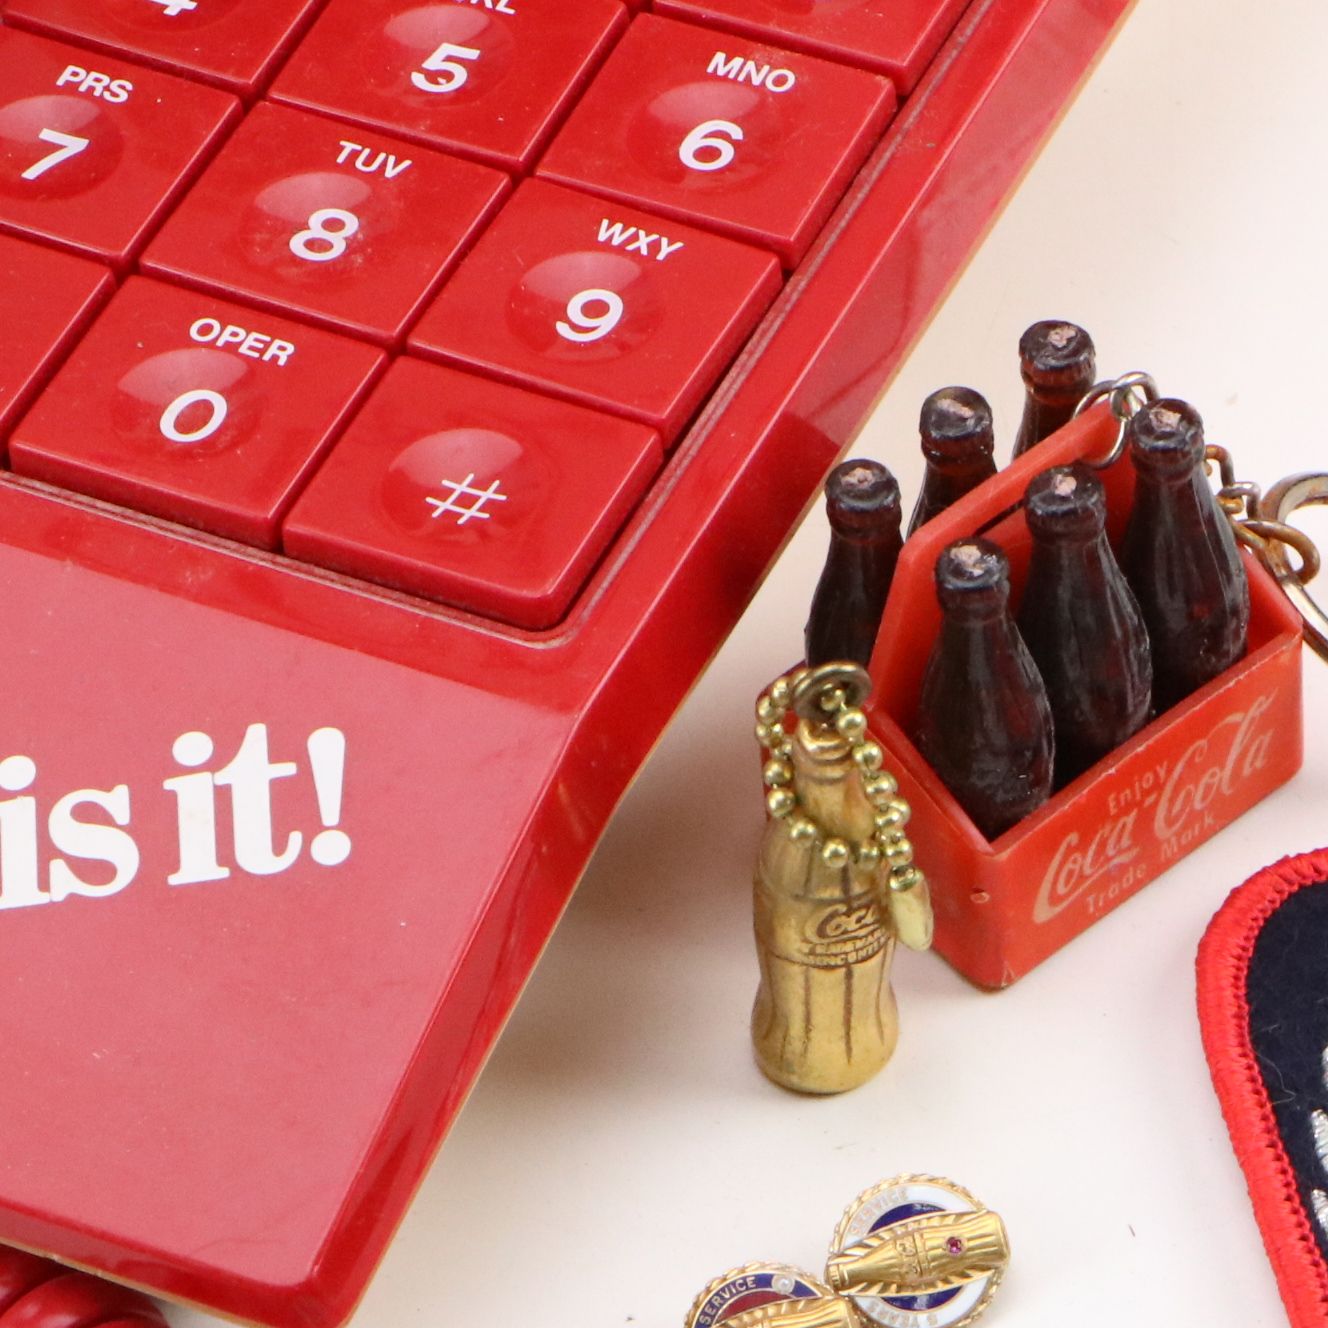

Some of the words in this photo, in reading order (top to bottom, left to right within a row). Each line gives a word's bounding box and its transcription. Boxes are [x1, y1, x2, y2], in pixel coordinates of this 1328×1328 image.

[56, 65, 133, 104] PRS
[410, 42, 481, 93] 5
[706, 51, 797, 93] MNO
[21, 127, 89, 180] 7
[335, 140, 412, 178] TUV
[678, 119, 744, 171] 6
[289, 207, 360, 261] 8
[597, 218, 684, 261] WXY
[555, 288, 624, 342] 9
[189, 317, 295, 366] OPER
[425, 472, 507, 525] #
[1108, 761, 1169, 815] Enjoy
[0, 755, 140, 910] is
[163, 722, 352, 886] it!
[1084, 863, 1147, 914] Trade
[1161, 810, 1217, 862] Mark
[698, 1275, 757, 1327] SERVICE
